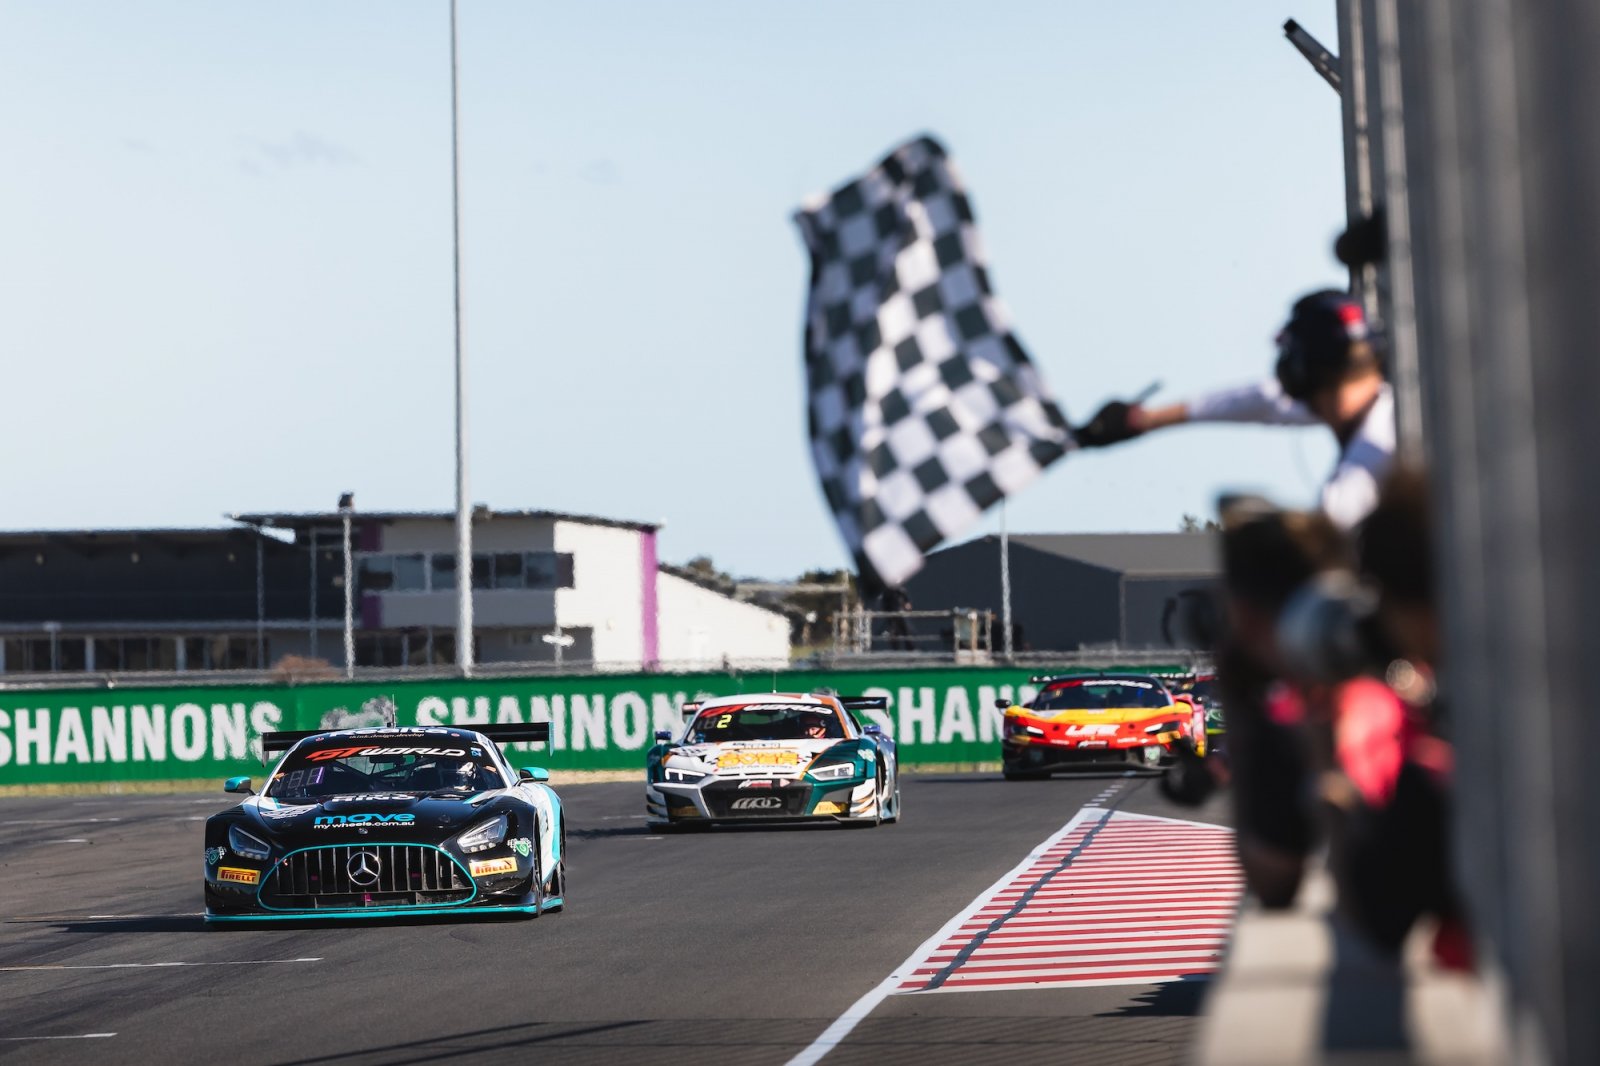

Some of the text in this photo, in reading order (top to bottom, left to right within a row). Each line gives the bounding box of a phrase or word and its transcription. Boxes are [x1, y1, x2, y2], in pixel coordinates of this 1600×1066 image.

[716, 714, 732, 729] 2
[314, 812, 416, 825] move
[331, 820, 416, 829] wheels.com.au
[475, 860, 514, 874] PIRELLI
[221, 869, 257, 884] PIRELLI
